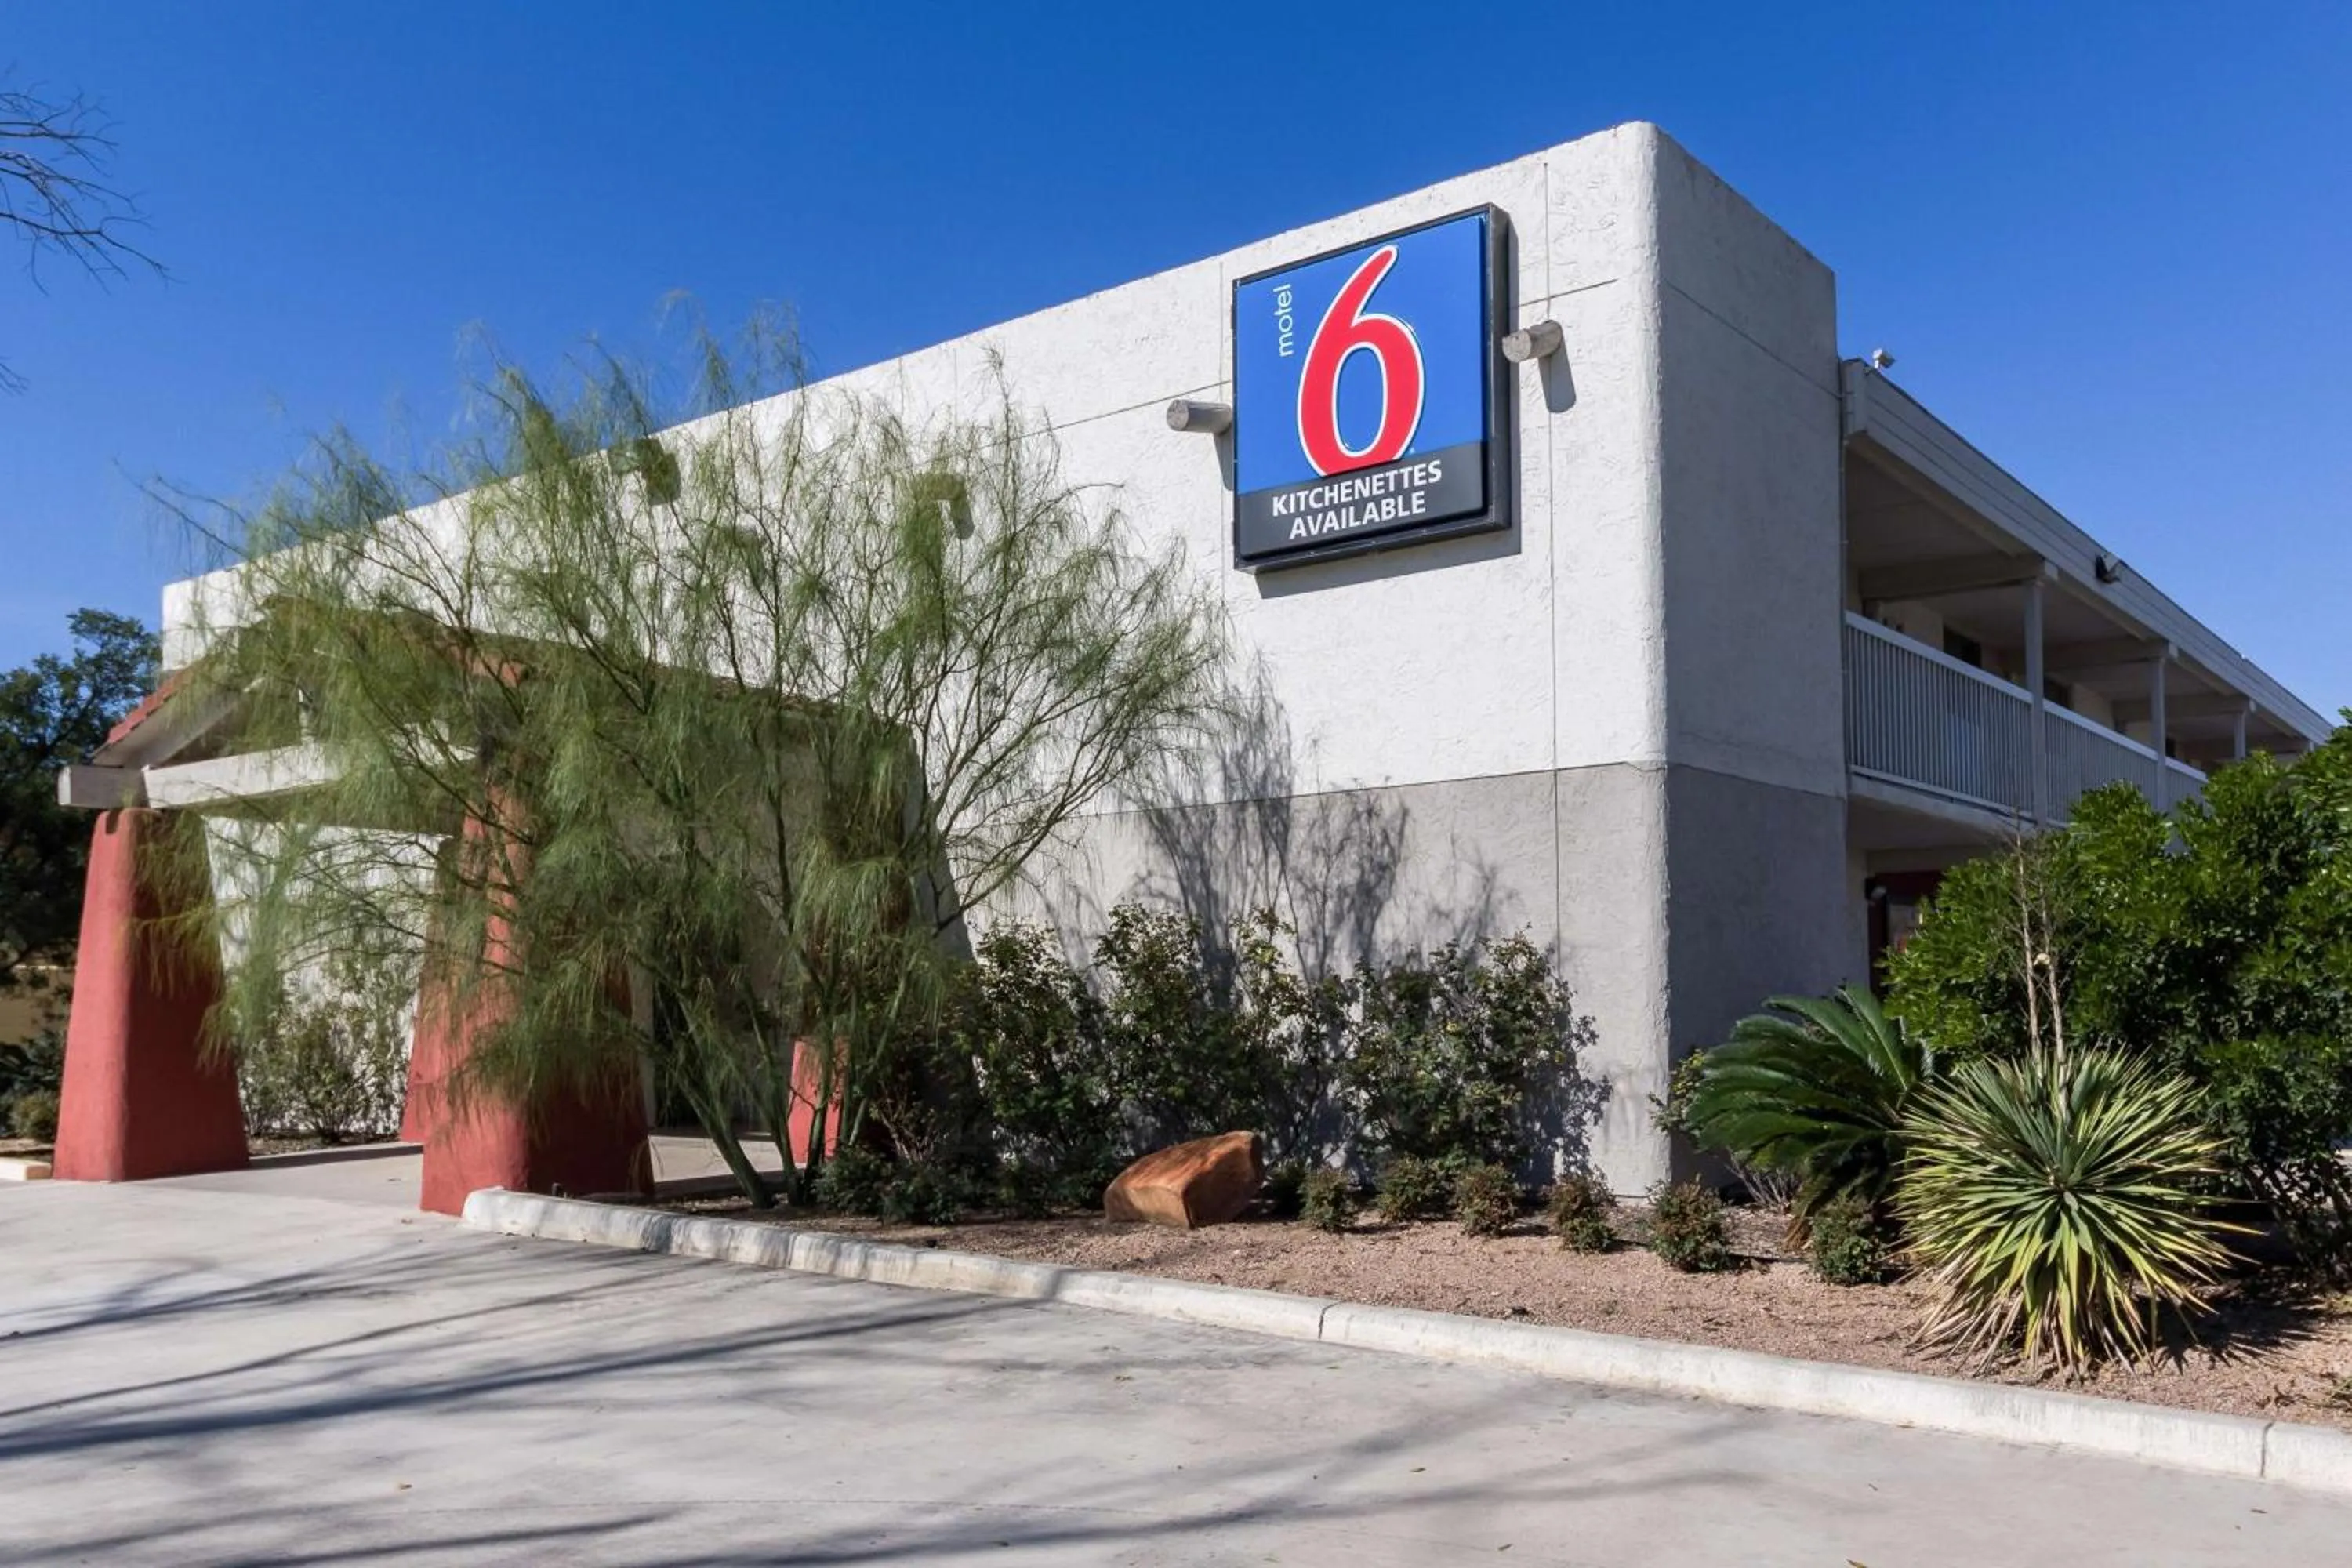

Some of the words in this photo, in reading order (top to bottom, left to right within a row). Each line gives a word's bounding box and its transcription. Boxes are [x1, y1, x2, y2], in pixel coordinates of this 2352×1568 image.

[1272, 283, 1294, 358] motel
[1296, 244, 1425, 477] 6
[1272, 459, 1443, 517] KITCHENETTES
[1290, 491, 1426, 540] AVAILABLE
